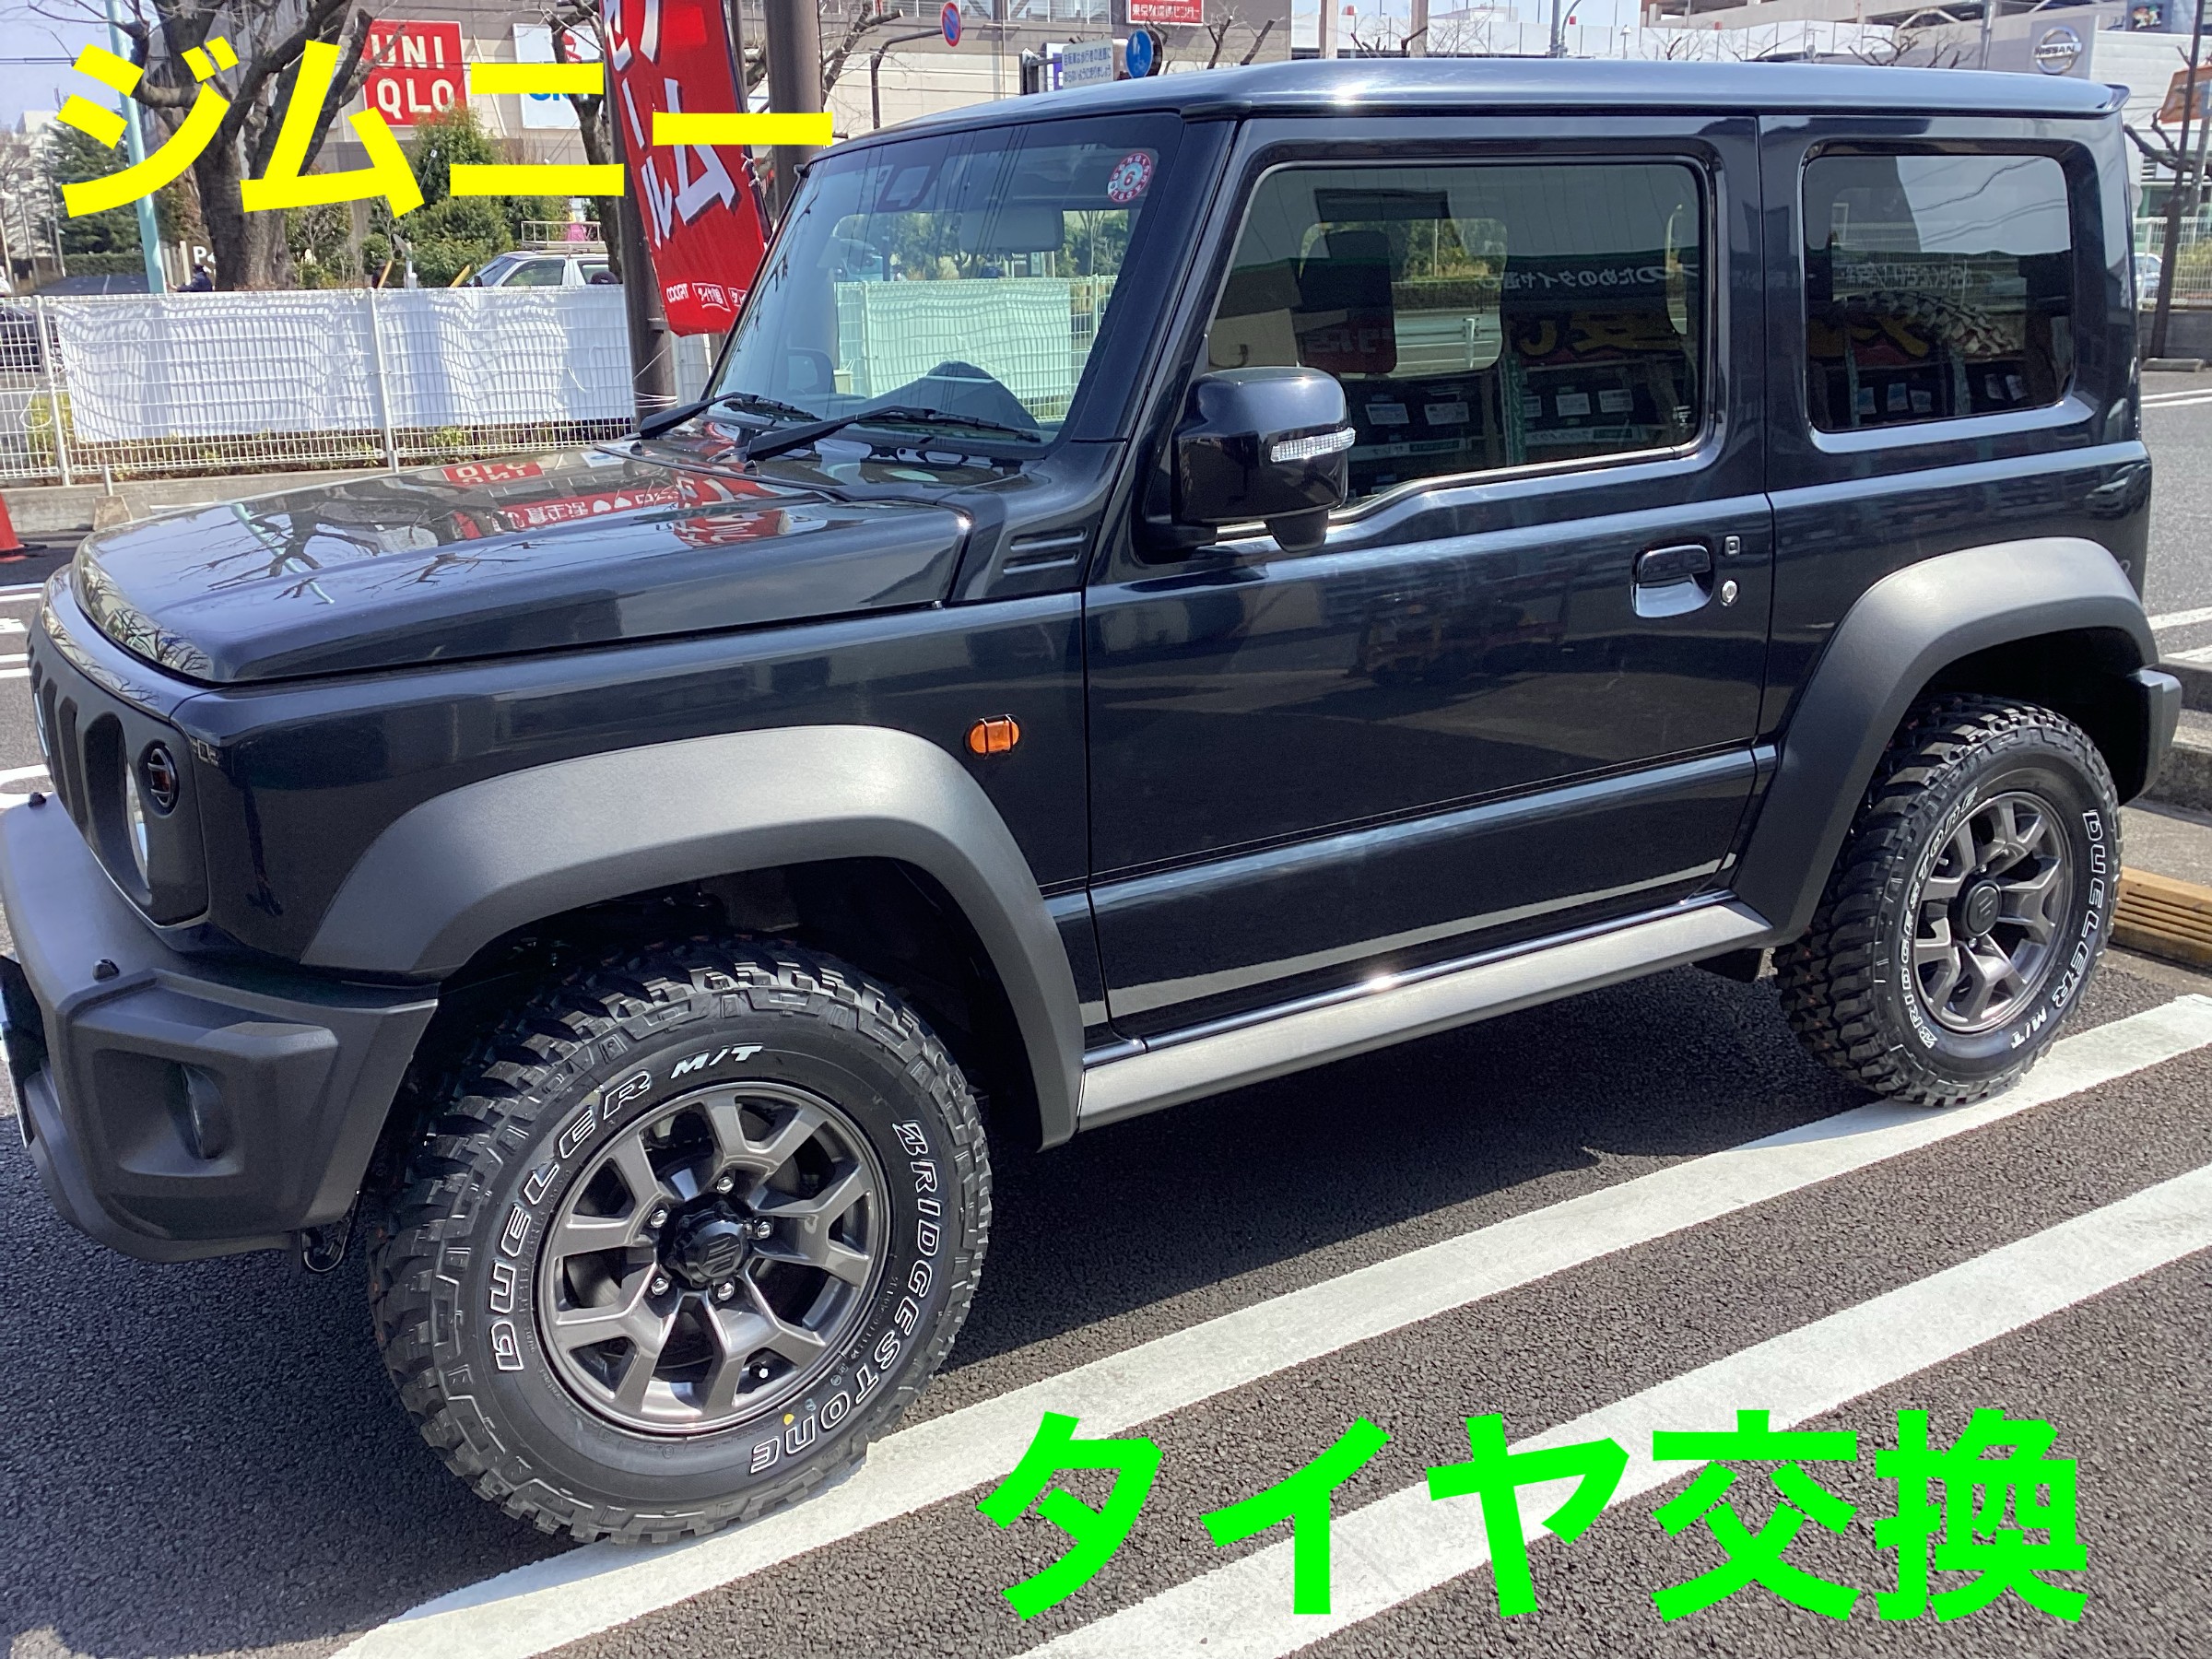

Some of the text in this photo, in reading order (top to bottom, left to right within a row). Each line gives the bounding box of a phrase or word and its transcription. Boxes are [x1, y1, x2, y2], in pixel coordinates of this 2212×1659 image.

[371, 34, 444, 69] UNI
[377, 77, 455, 119] QLO
[2034, 44, 2075, 56] NISSAN
[1124, 171, 1135, 186] 6
[1899, 785, 1979, 1049] BRIDGESTONE
[2010, 808, 2107, 1050] DUELER M/T
[484, 1068, 653, 1371] DUELER
[670, 1041, 764, 1080] M/T
[749, 1120, 943, 1475] BRIDGESTONE
